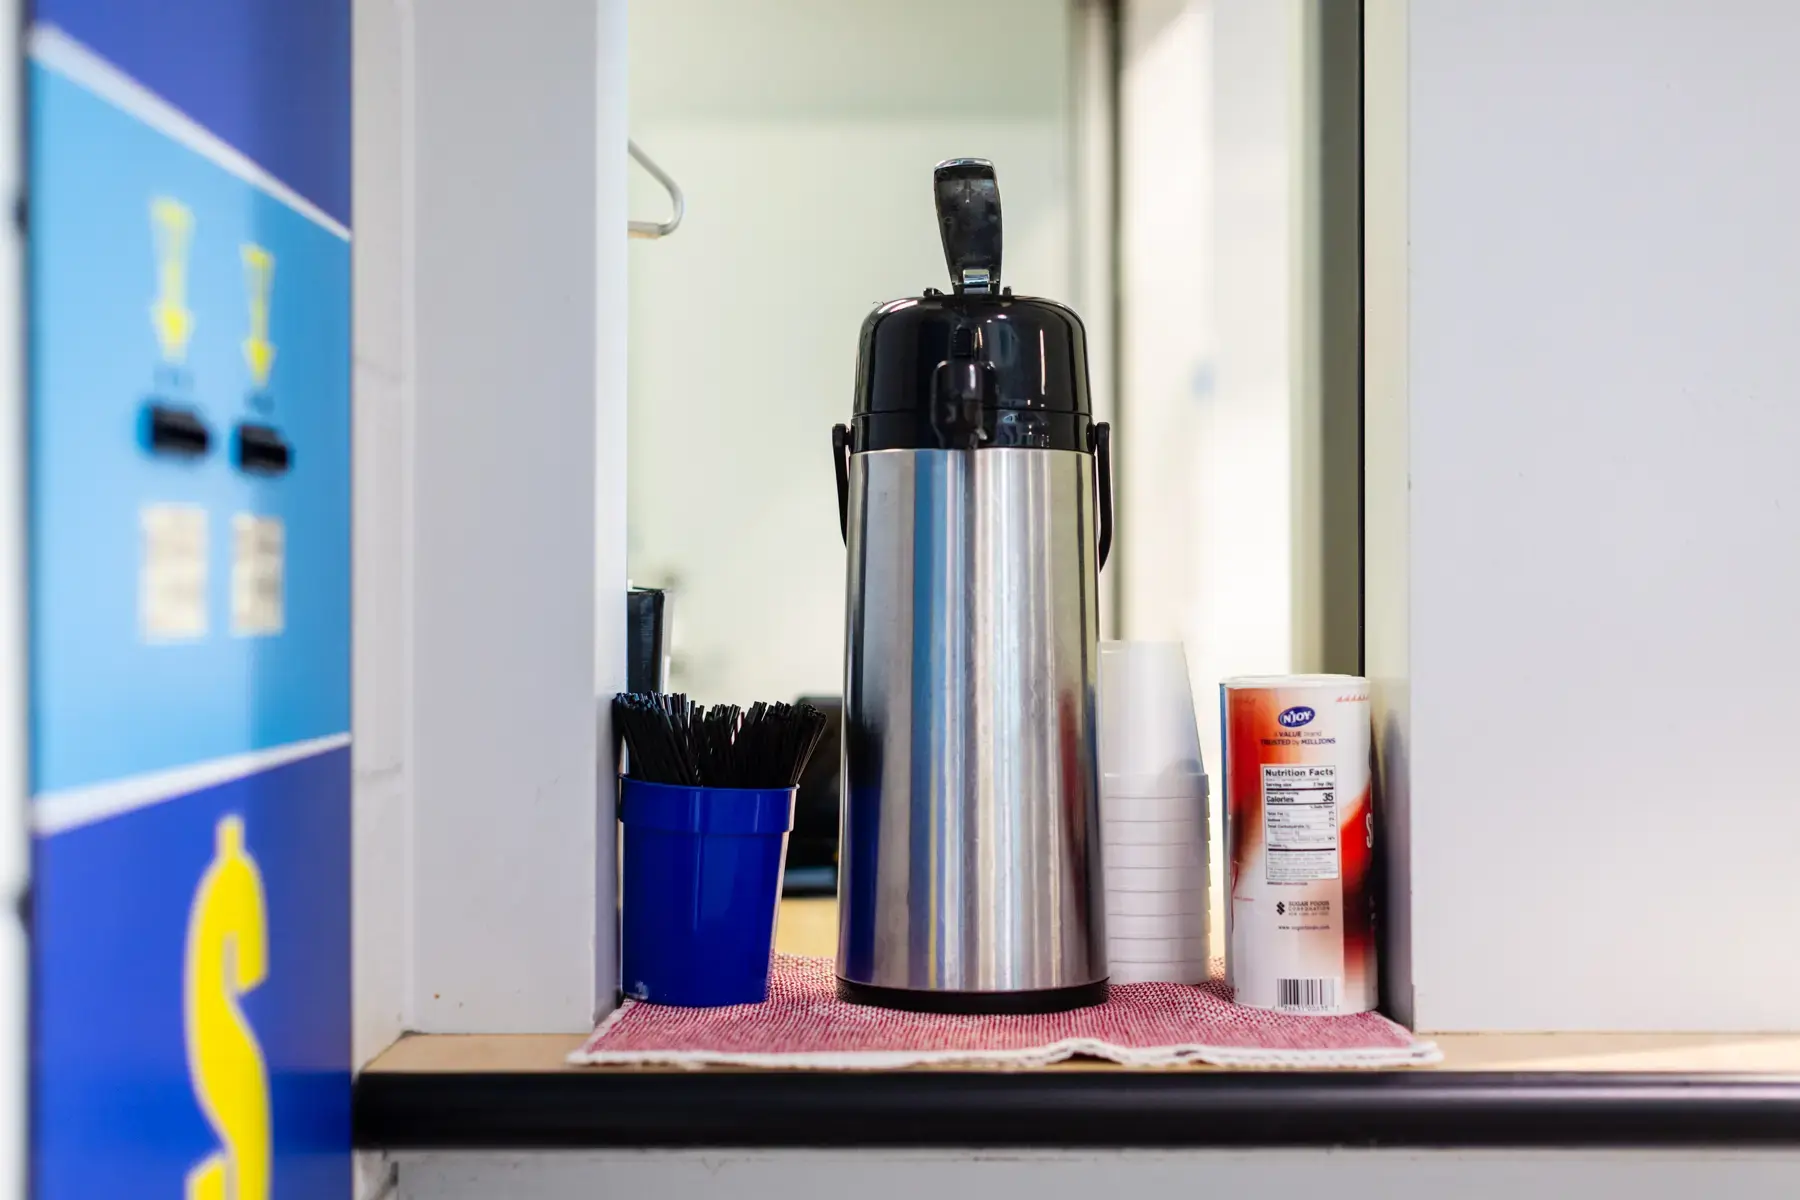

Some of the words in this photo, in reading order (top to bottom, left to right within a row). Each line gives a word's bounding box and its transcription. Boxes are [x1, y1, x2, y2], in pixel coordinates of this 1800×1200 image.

[1261, 738, 1291, 746] TRUSTED
[1265, 769, 1306, 777] Nutrition
[1322, 792, 1334, 802] 35
